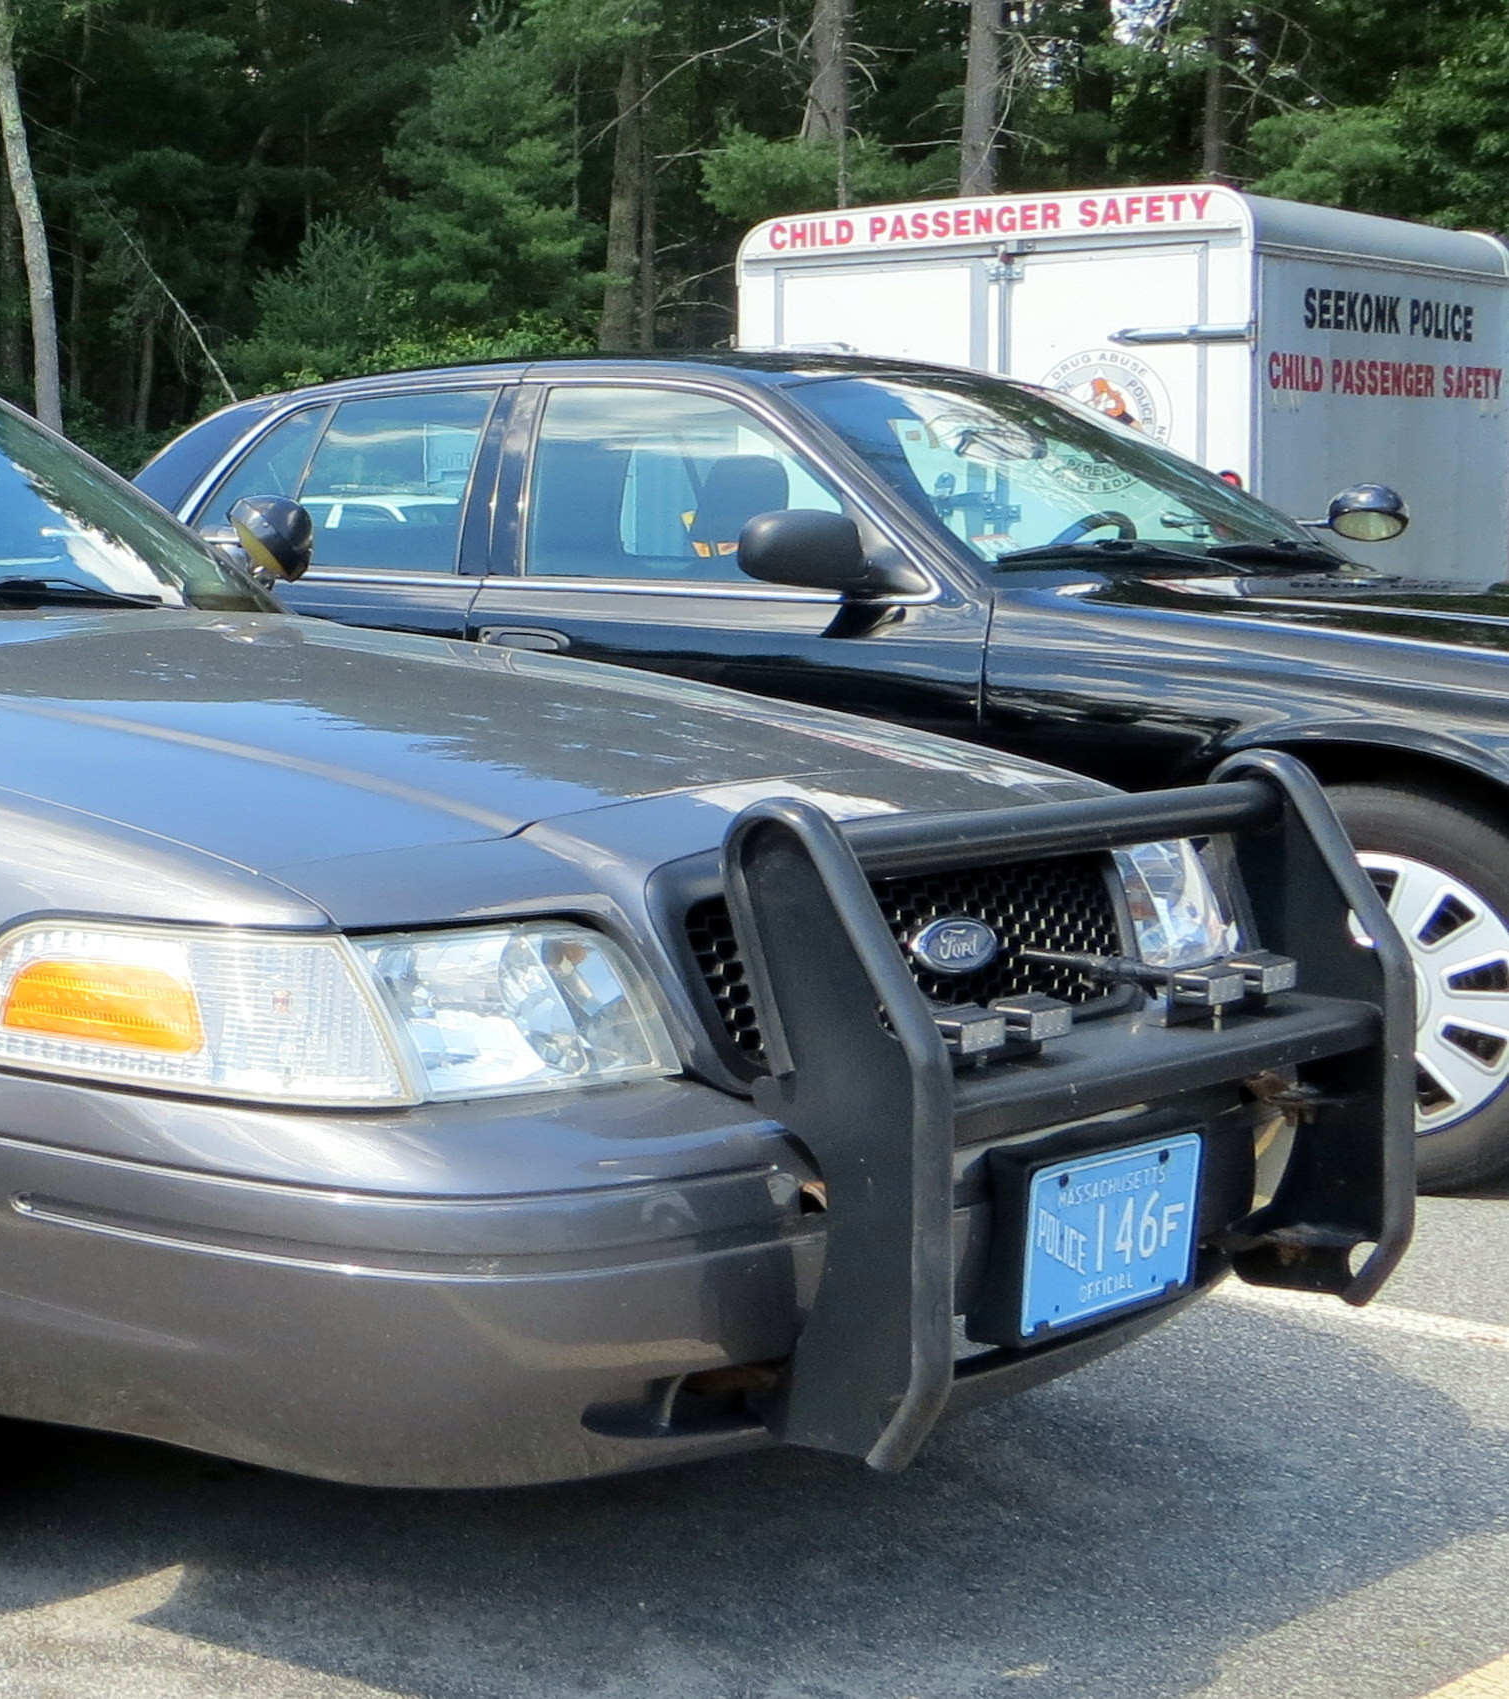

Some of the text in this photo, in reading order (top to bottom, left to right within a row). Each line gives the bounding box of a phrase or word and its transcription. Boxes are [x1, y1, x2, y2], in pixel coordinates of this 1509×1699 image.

[768, 190, 1213, 251] CHILD PASSENGER SAFETY
[1303, 287, 1475, 343] SEEKONK POLICE
[1050, 352, 1149, 382] DRUG ABUSE
[1268, 351, 1503, 400] CHILD PASSENGER SAFETY
[1125, 378, 1153, 425] POLICE
[939, 928, 980, 961] Ford
[1057, 1163, 1167, 1208] MASSACHUSETTS
[1036, 1207, 1088, 1276] POLICE
[1094, 1188, 1186, 1273] 146F
[1078, 1272, 1134, 1304] OFFICIAL
